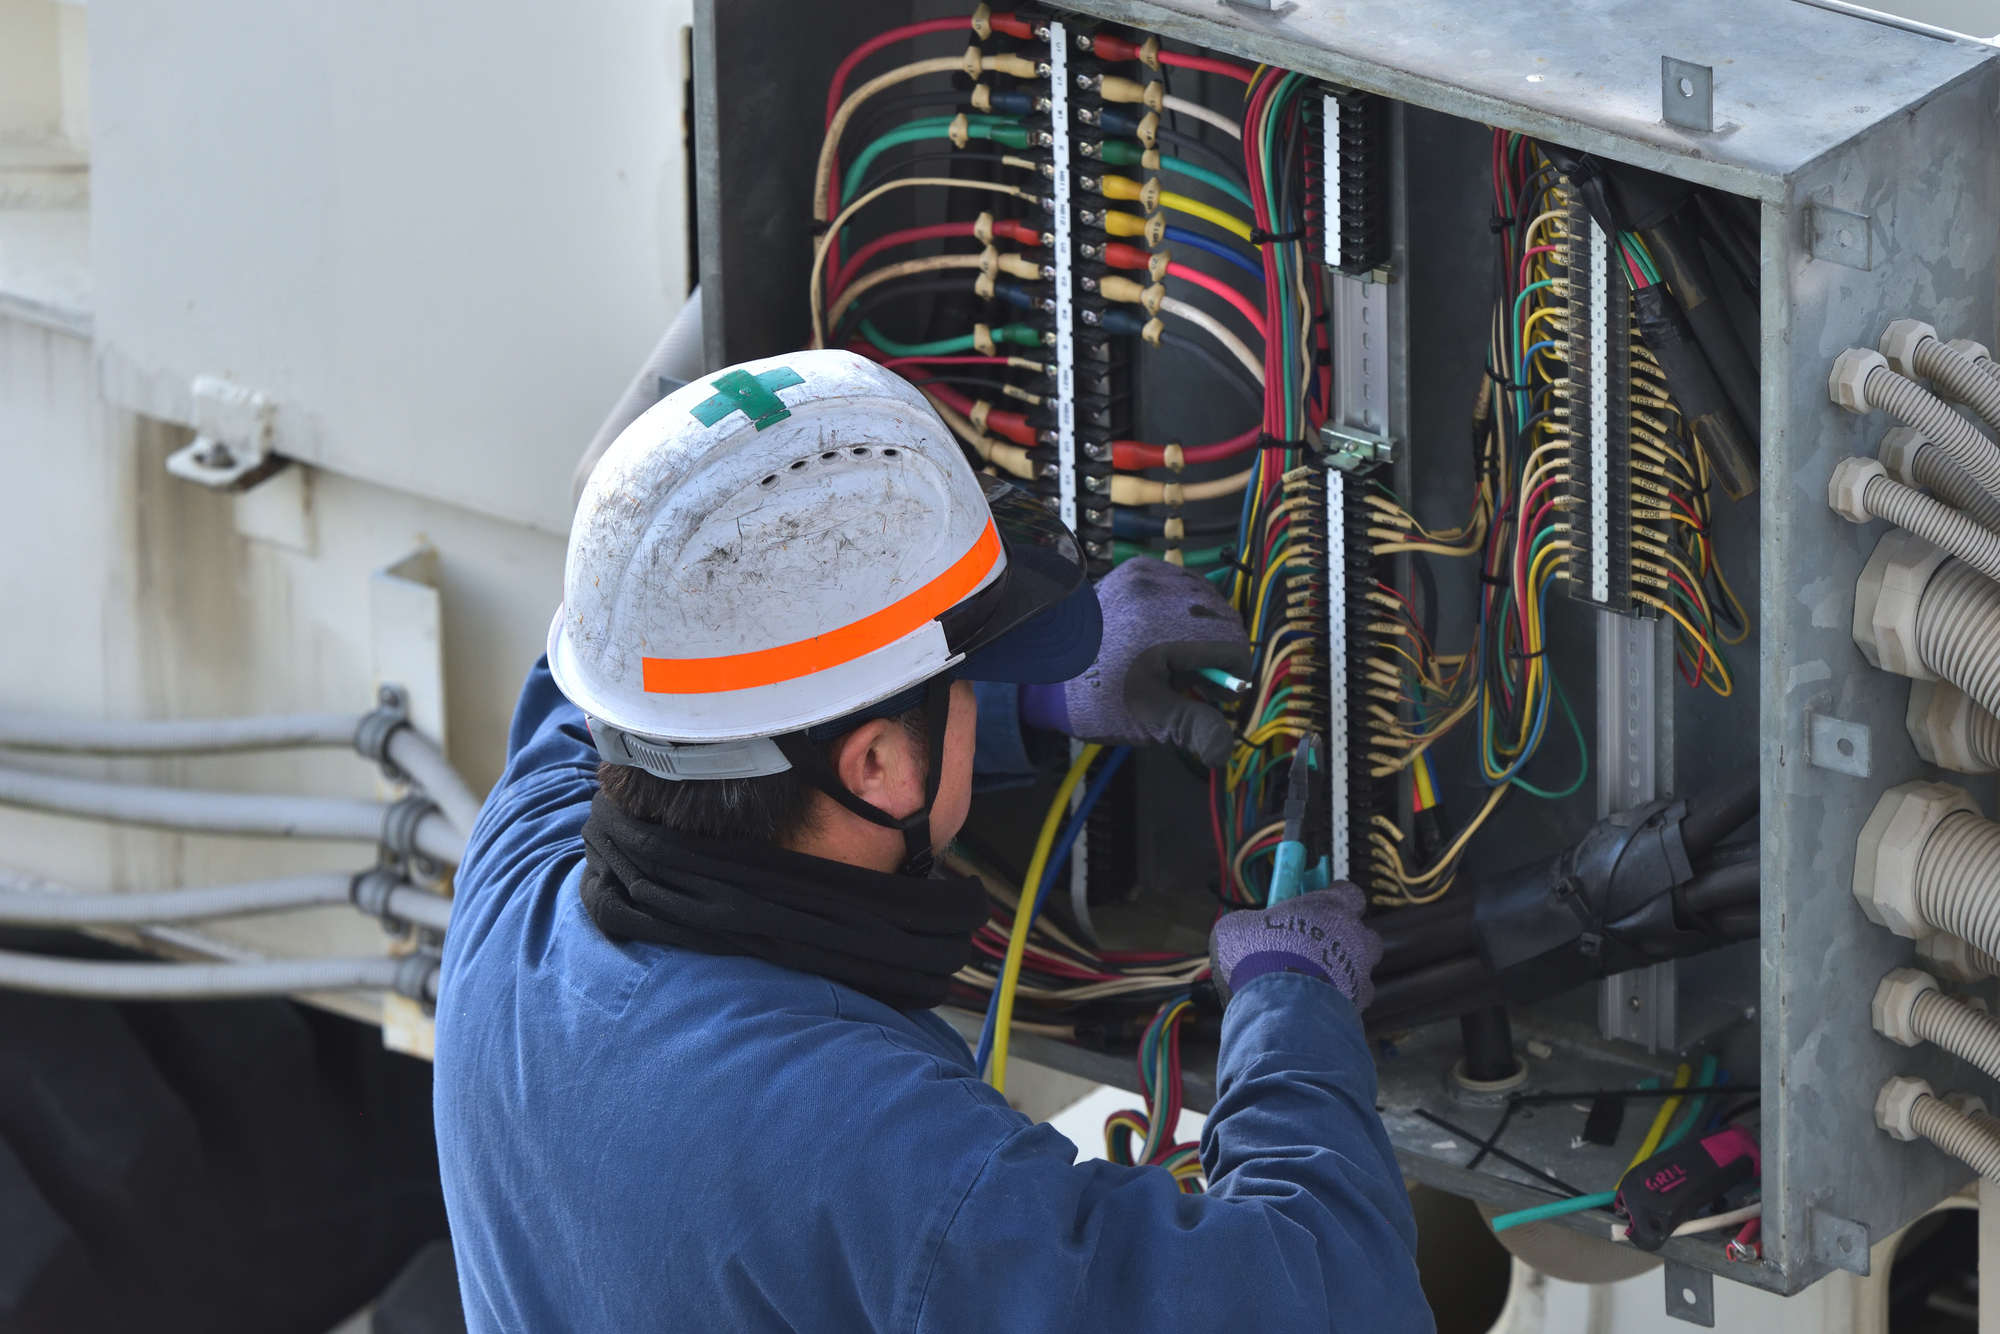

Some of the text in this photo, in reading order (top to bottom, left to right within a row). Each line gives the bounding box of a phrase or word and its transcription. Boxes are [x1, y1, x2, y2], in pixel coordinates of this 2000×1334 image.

[1150, 258, 1159, 270] U2
[1637, 363, 1657, 376] 1033
[1641, 382, 1655, 395] N24
[1635, 396, 1654, 406] 1034
[1641, 412, 1656, 424] N24
[1638, 431, 1656, 445] 1035
[1636, 461, 1655, 472] 1203
[1639, 479, 1659, 491] 1204
[1640, 495, 1661, 507] 1205
[1640, 510, 1660, 518] 1206
[1641, 528, 1656, 538] N24
[1264, 915, 1325, 942] Lite
